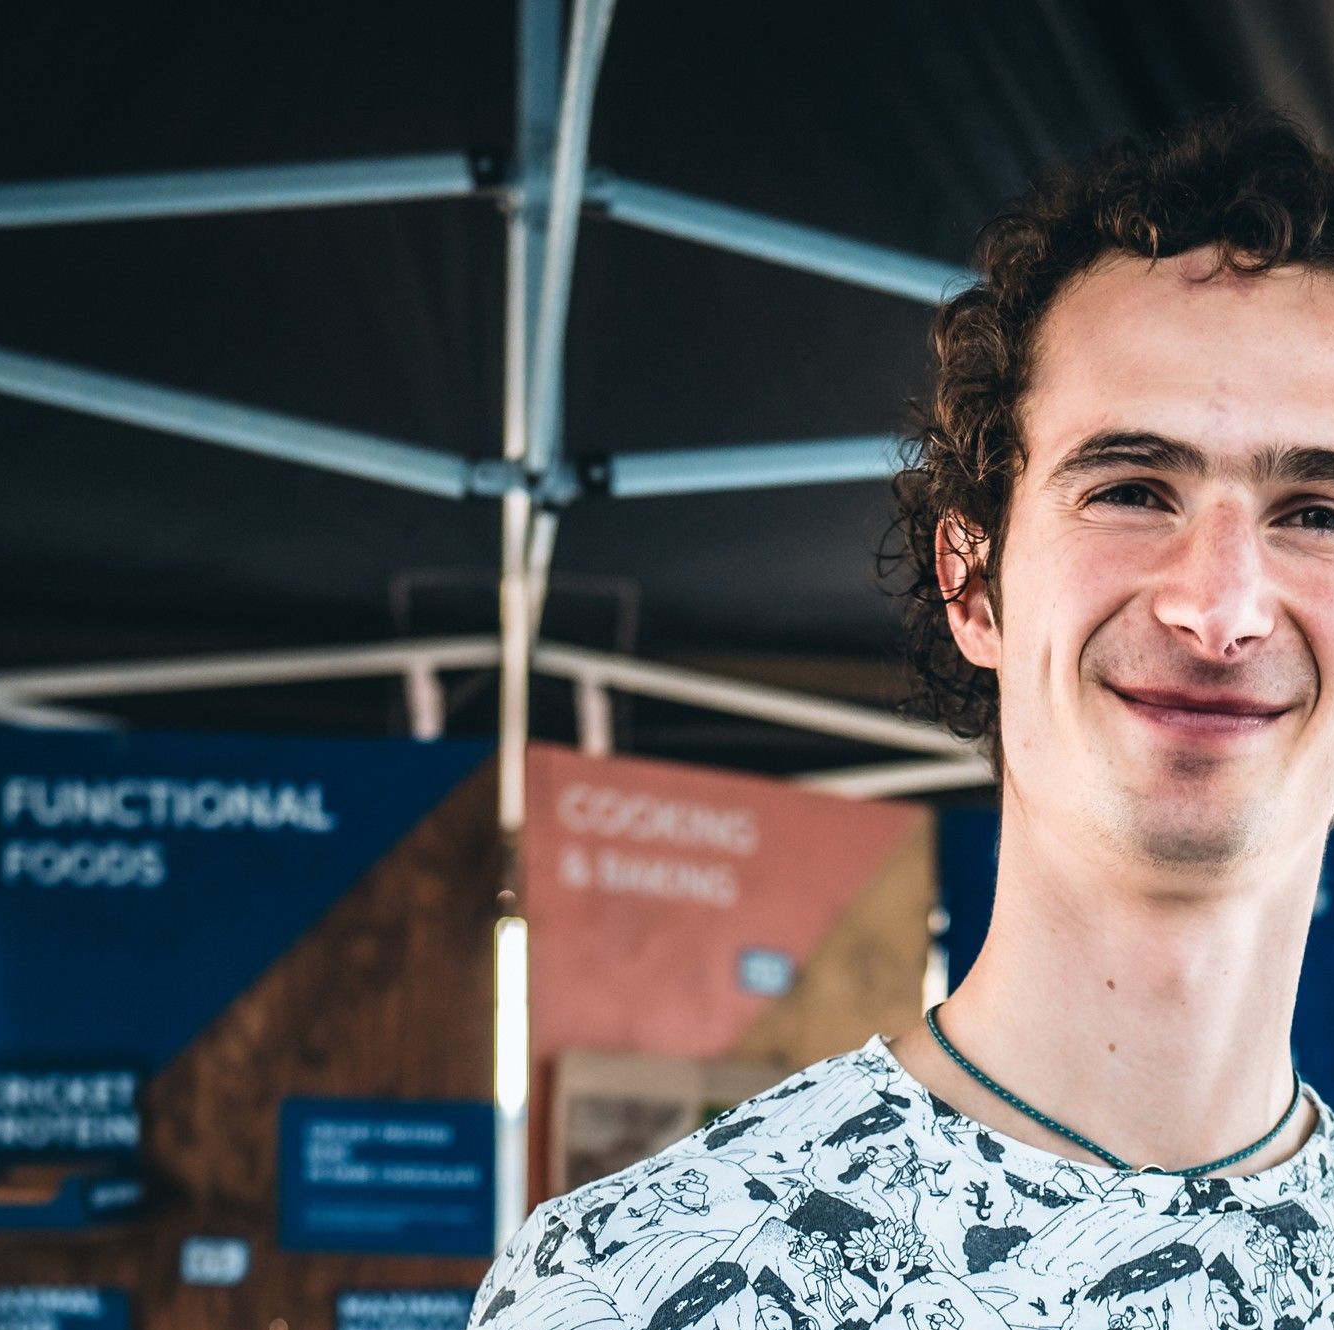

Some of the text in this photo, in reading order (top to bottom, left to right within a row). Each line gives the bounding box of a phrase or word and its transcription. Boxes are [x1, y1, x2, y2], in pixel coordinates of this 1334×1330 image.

[1, 776, 337, 832] FUNCTIONAL
[556, 782, 756, 857] COOKING
[1, 842, 166, 886] FOODS
